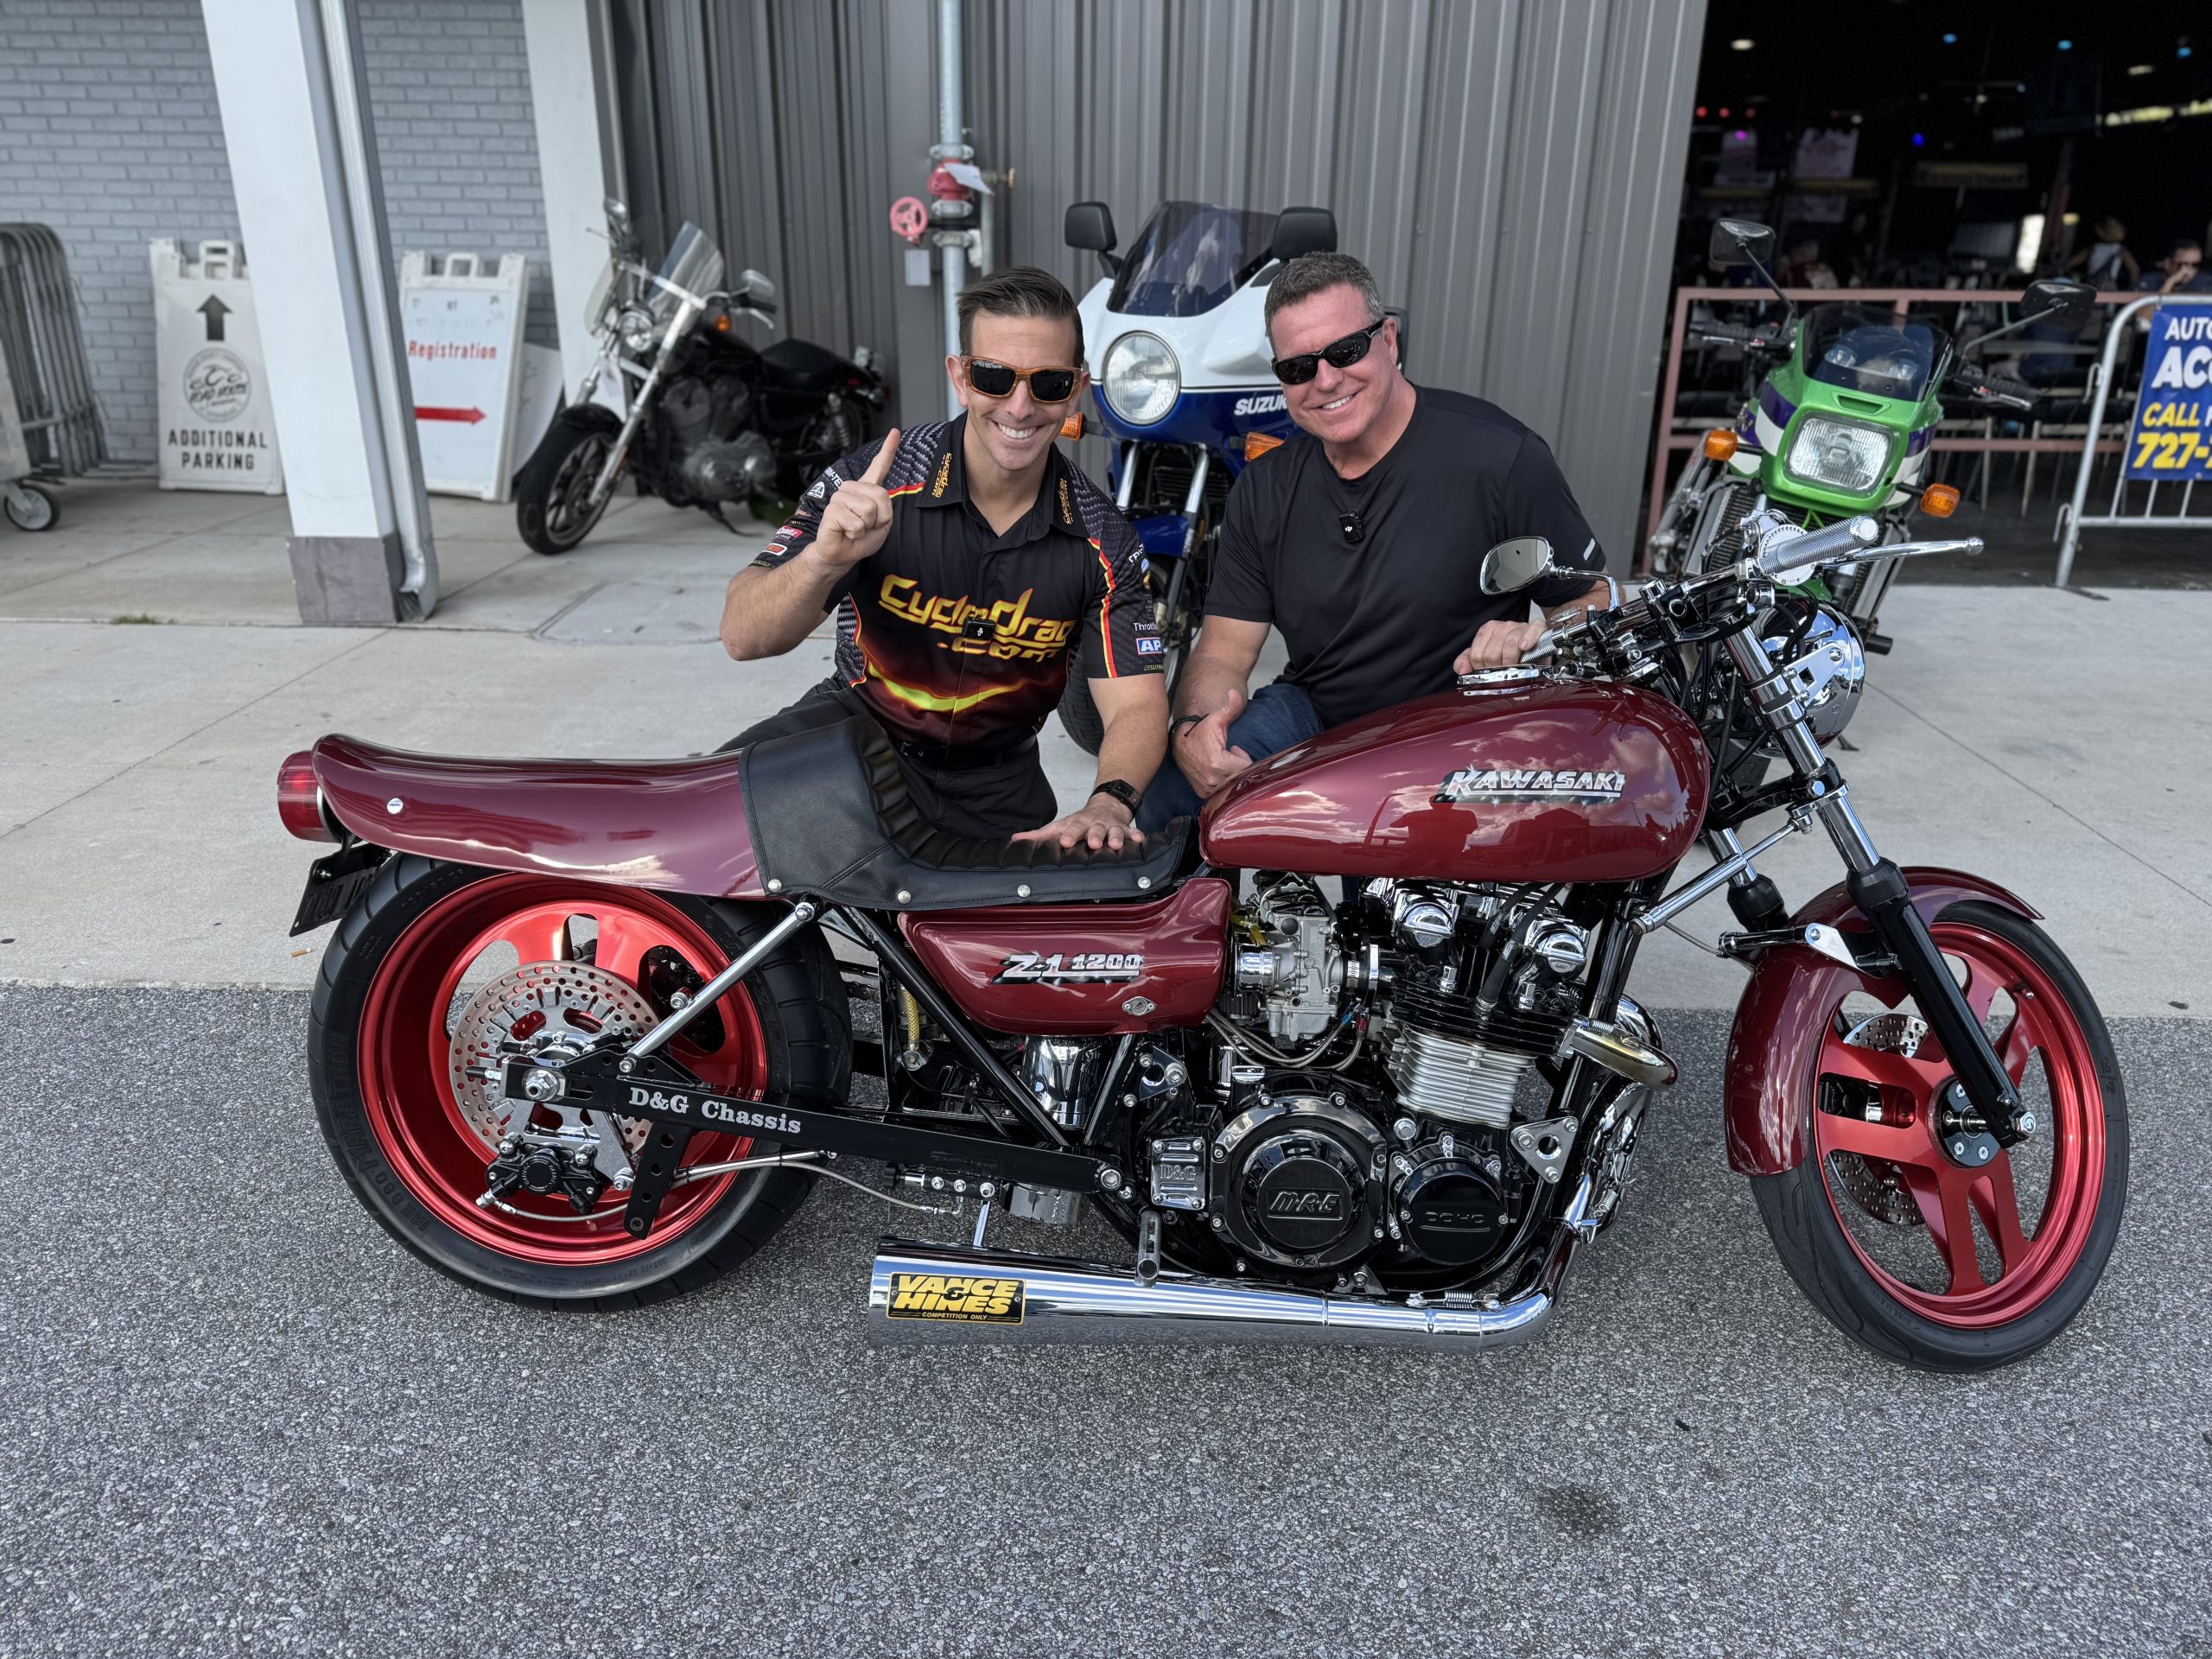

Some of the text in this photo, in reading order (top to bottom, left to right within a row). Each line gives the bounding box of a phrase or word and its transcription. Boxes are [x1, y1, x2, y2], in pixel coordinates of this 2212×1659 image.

[408, 340, 498, 361] Registration
[2151, 346, 2212, 389] AC
[1234, 394, 1287, 416] SUZUK
[2142, 402, 2201, 428] CALL
[168, 429, 269, 449] ADDITIONAL
[2132, 431, 2212, 469] 727-
[181, 452, 255, 471] PARKING
[1444, 770, 1626, 796] KAWASAKI
[1071, 953, 1141, 970] 1200
[628, 1087, 802, 1135] D&G Chassis
[1160, 1164, 1198, 1181] D&G
[898, 1274, 1020, 1298] VANCE
[893, 1292, 1012, 1315] HINES
[921, 1311, 968, 1320] COMPETITION
